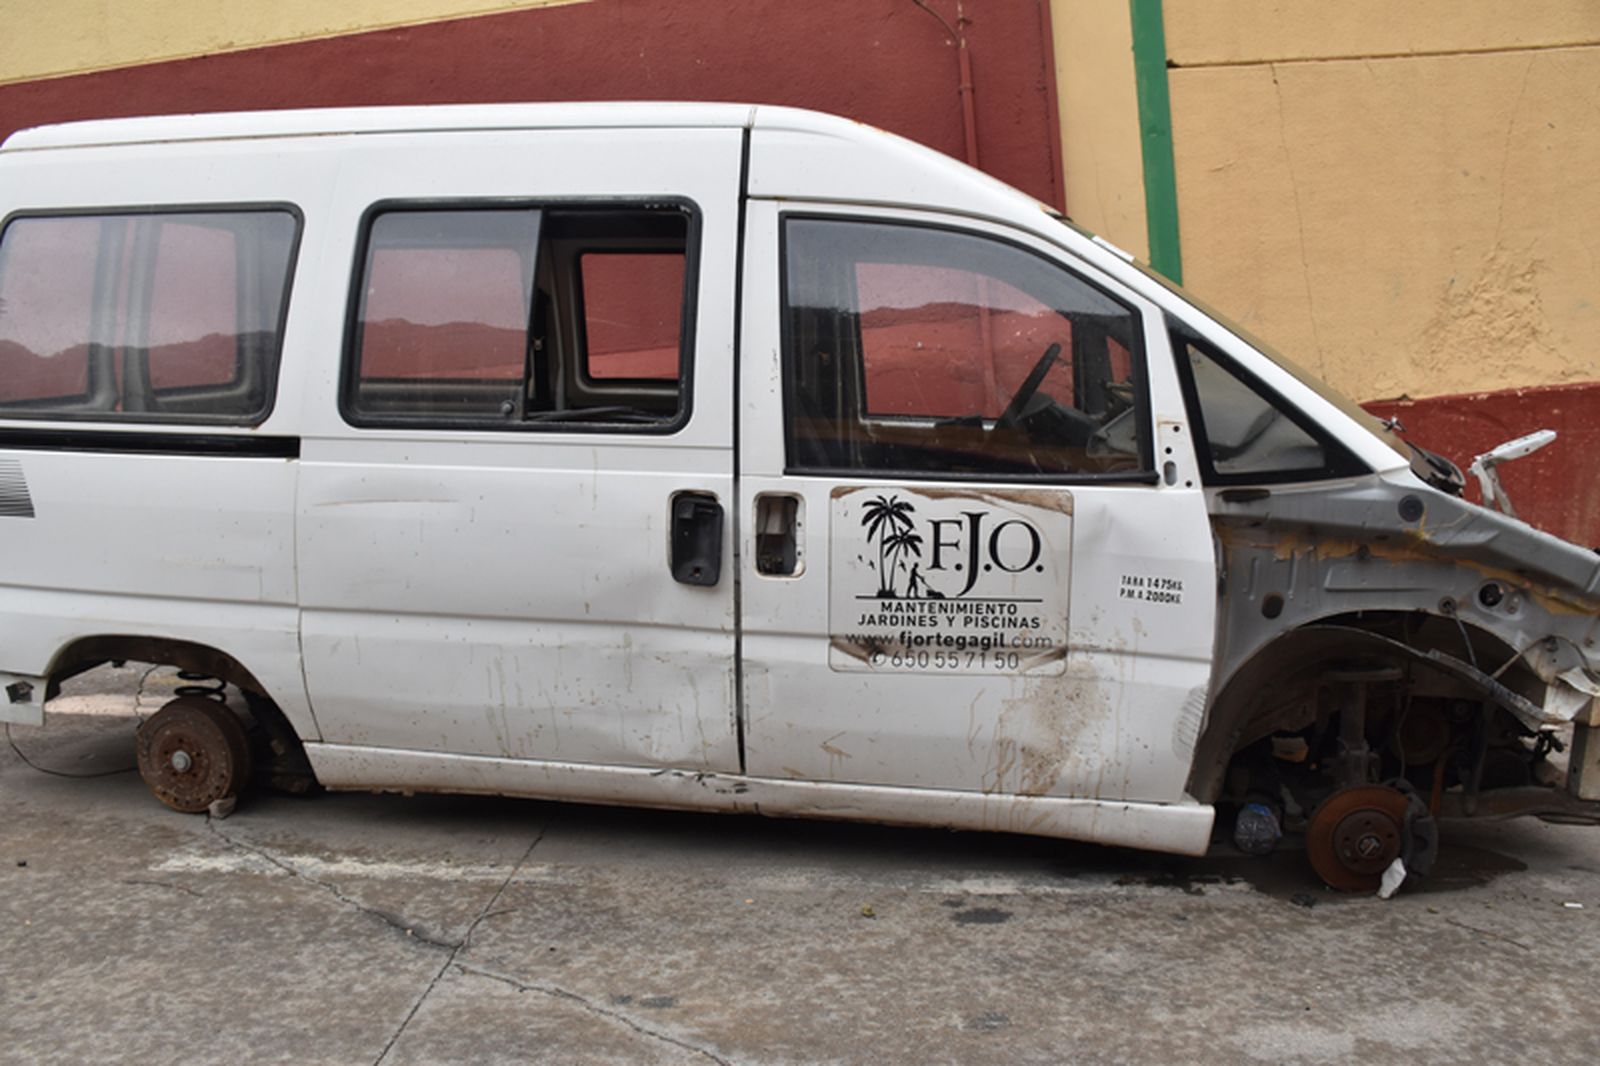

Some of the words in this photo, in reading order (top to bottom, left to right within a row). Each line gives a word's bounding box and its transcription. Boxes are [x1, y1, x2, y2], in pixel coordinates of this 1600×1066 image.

[926, 511, 1044, 598] F.J.O.
[881, 602, 1018, 615] MANTENIMIENTO
[858, 614, 938, 627] JARDINES
[945, 617, 955, 628] Y
[963, 617, 1041, 629] PISCINAS
[845, 631, 1053, 651] www.fjortegagil.com
[892, 651, 929, 668] 650
[935, 652, 959, 669] 55
[965, 652, 987, 669] 71
[995, 652, 1019, 669] 50
